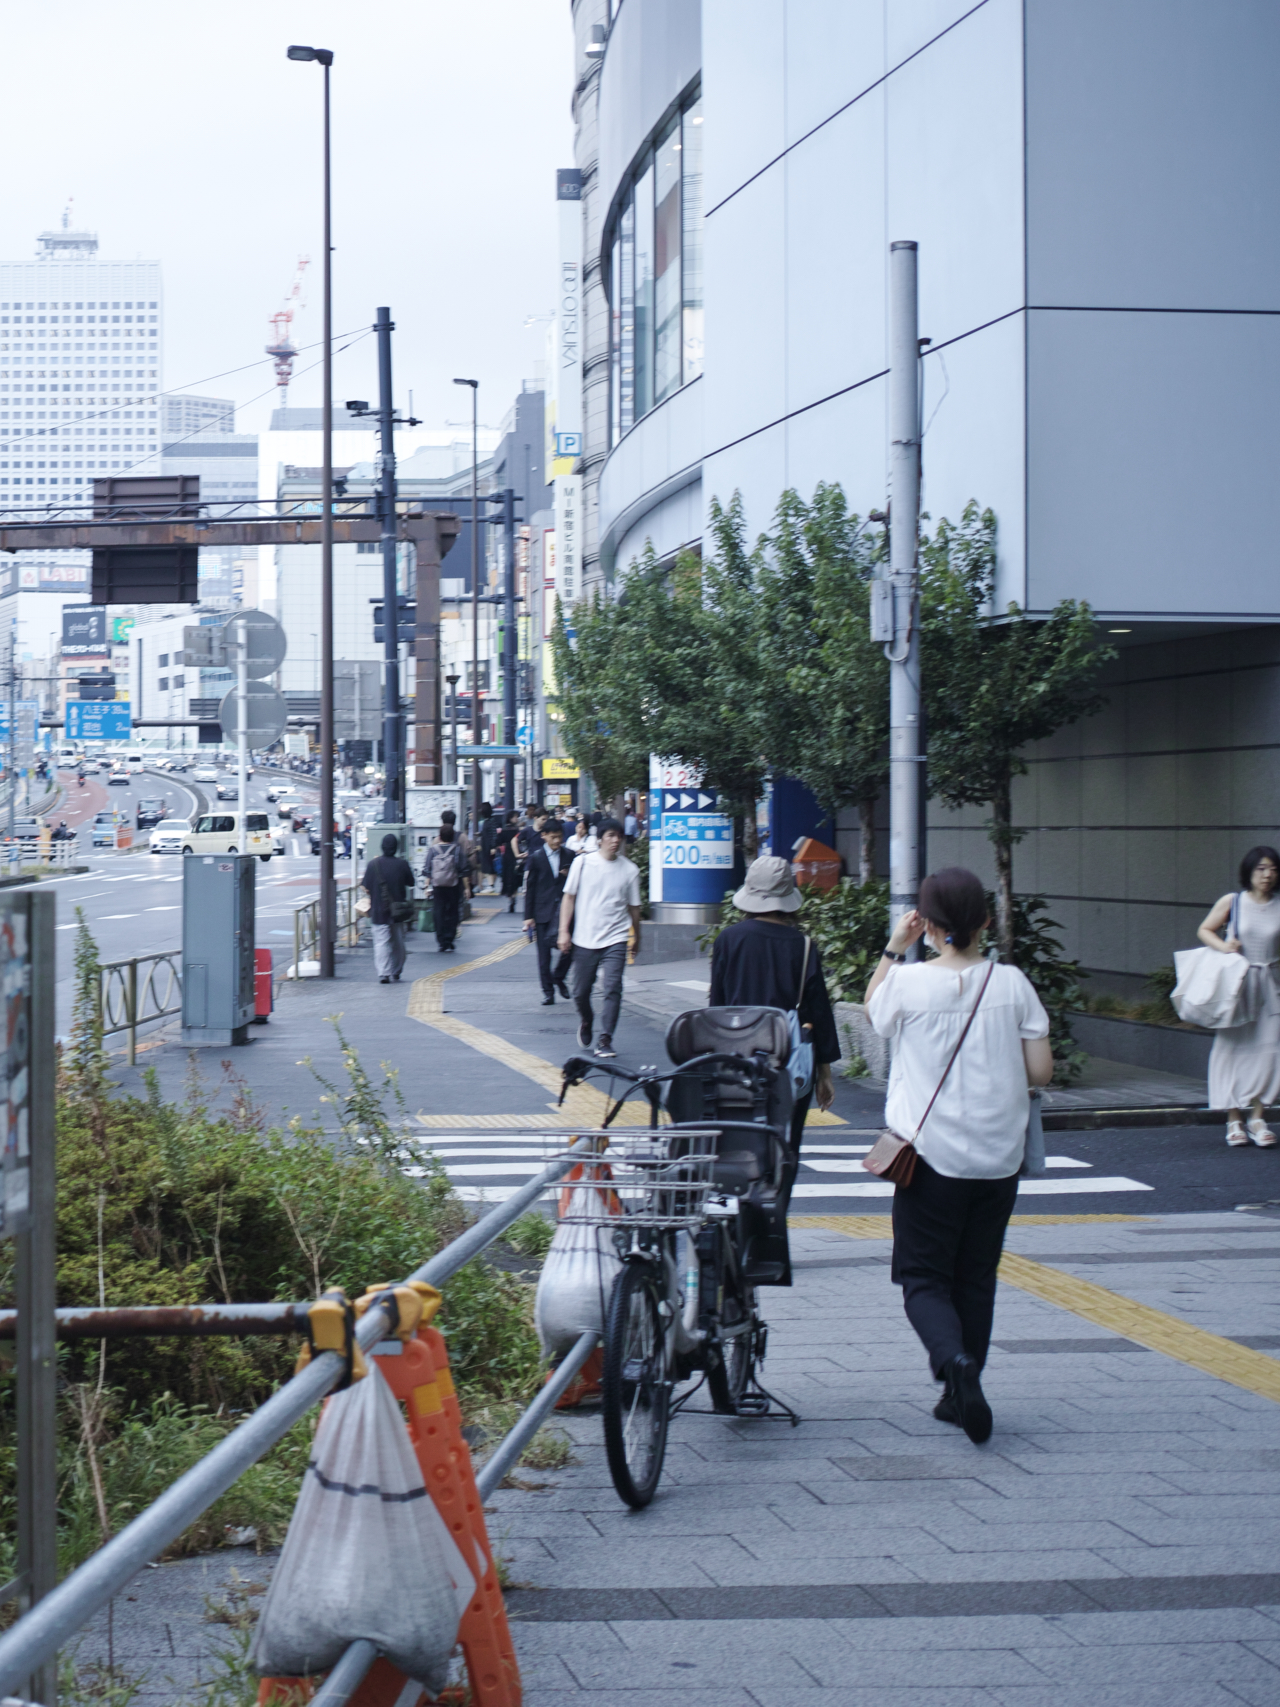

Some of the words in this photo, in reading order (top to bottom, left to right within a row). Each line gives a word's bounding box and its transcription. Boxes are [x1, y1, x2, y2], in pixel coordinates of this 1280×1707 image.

[561, 295, 579, 369] OTSUKA
[564, 437, 575, 451] P
[39, 567, 84, 581] LABI
[82, 705, 110, 715] 八王子
